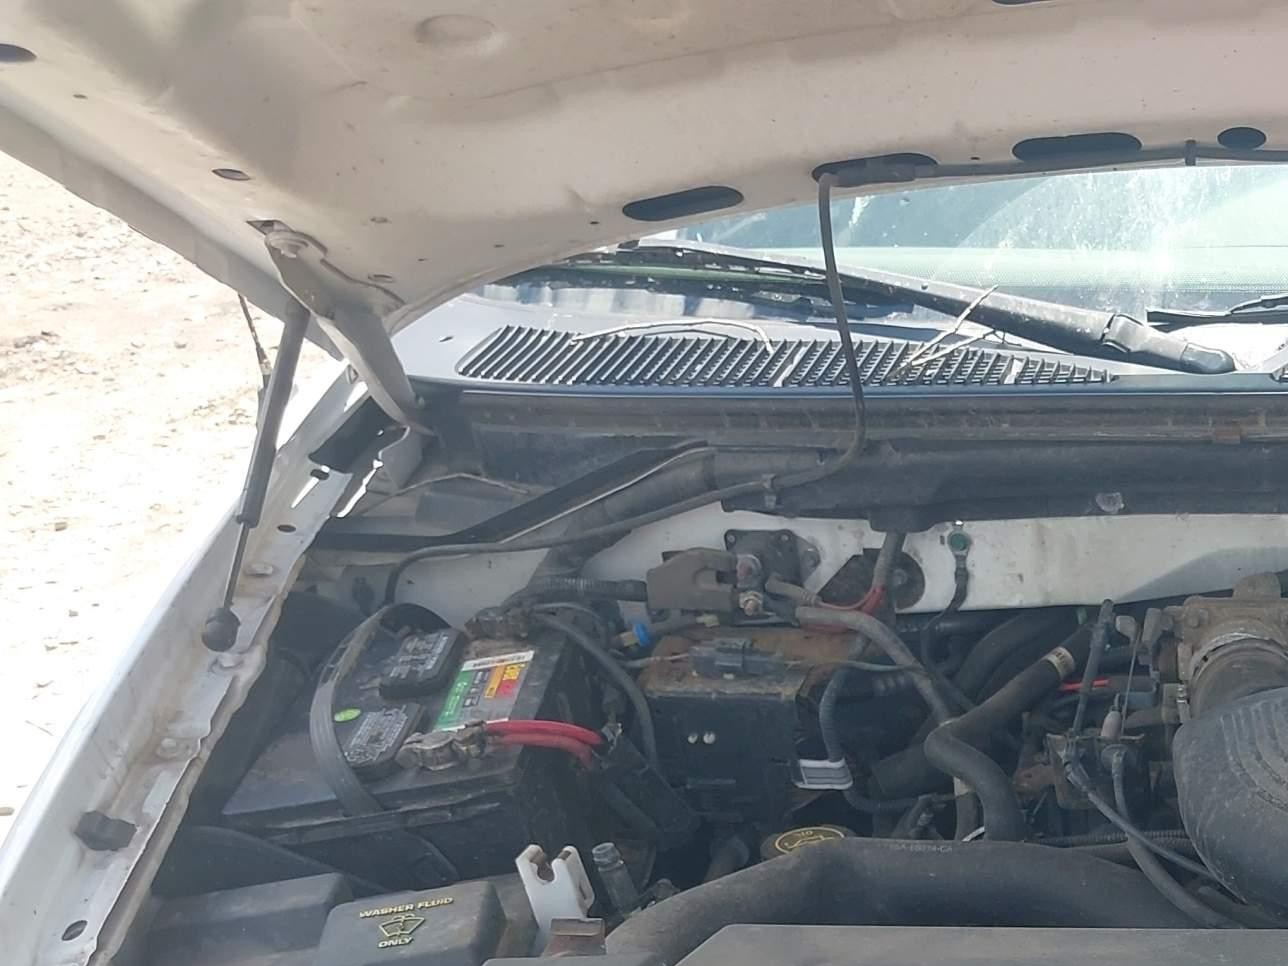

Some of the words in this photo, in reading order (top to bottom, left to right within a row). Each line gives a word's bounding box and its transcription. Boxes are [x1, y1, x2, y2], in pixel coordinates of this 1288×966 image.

[360, 904, 414, 918] WASHER
[417, 898, 453, 909] FLUID
[378, 937, 413, 948] ONLY
